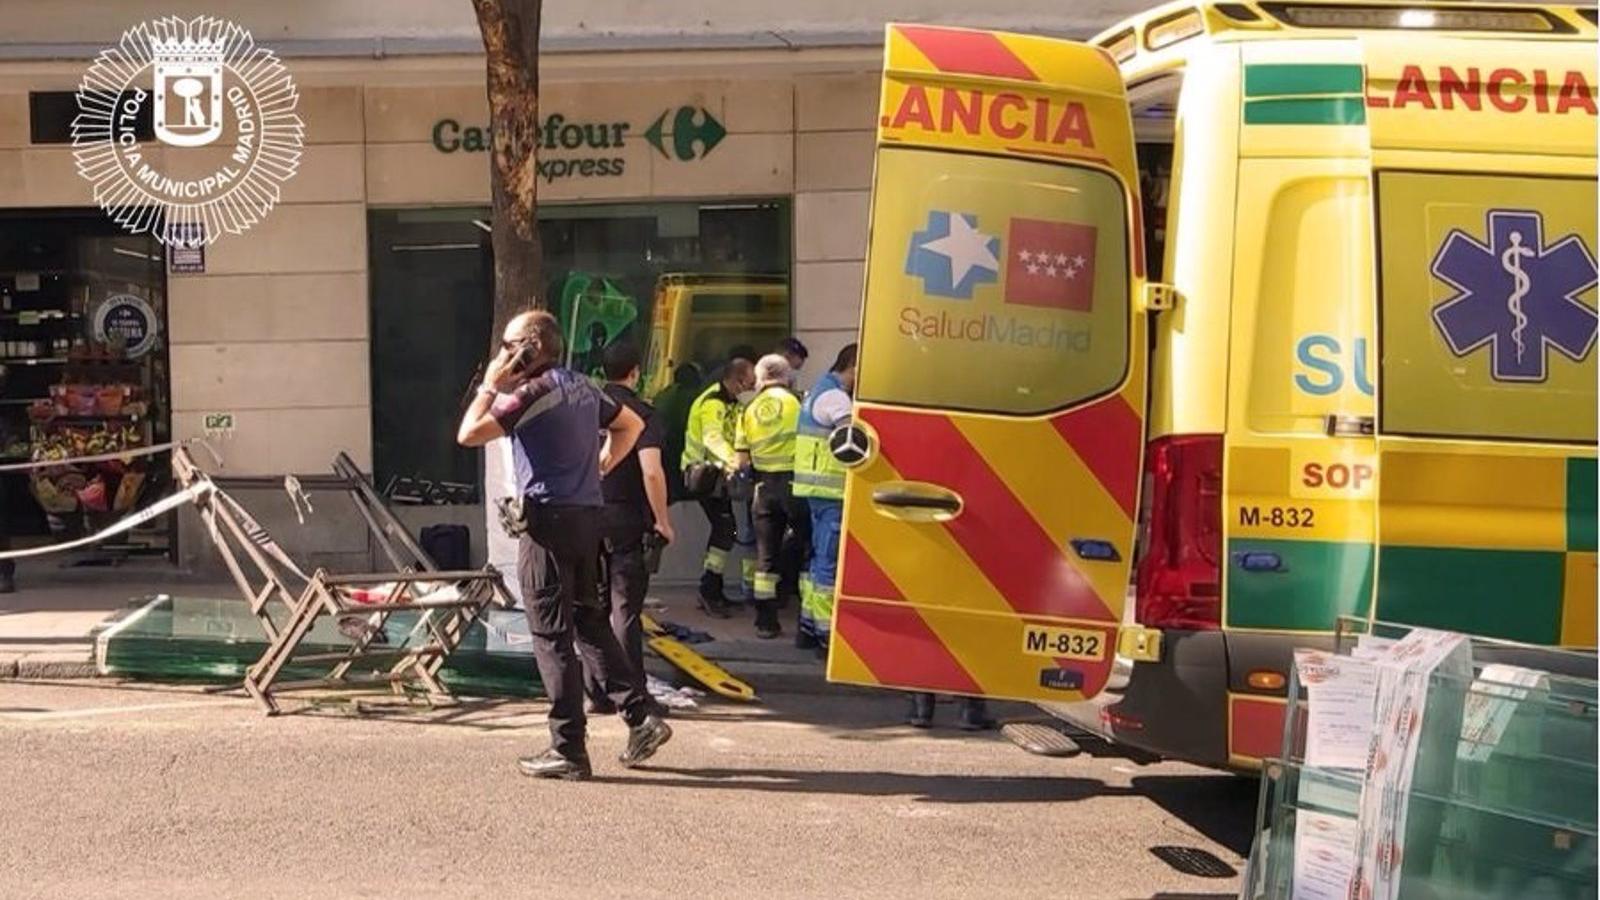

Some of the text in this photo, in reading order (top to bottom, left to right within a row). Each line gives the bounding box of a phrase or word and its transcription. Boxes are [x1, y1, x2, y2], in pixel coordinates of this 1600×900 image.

[881, 84, 1096, 149] ANCIA
[536, 155, 625, 182] xpress
[1302, 463, 1373, 489] SOP
[1239, 507, 1315, 528] M-832
[1026, 631, 1099, 656] M-832
